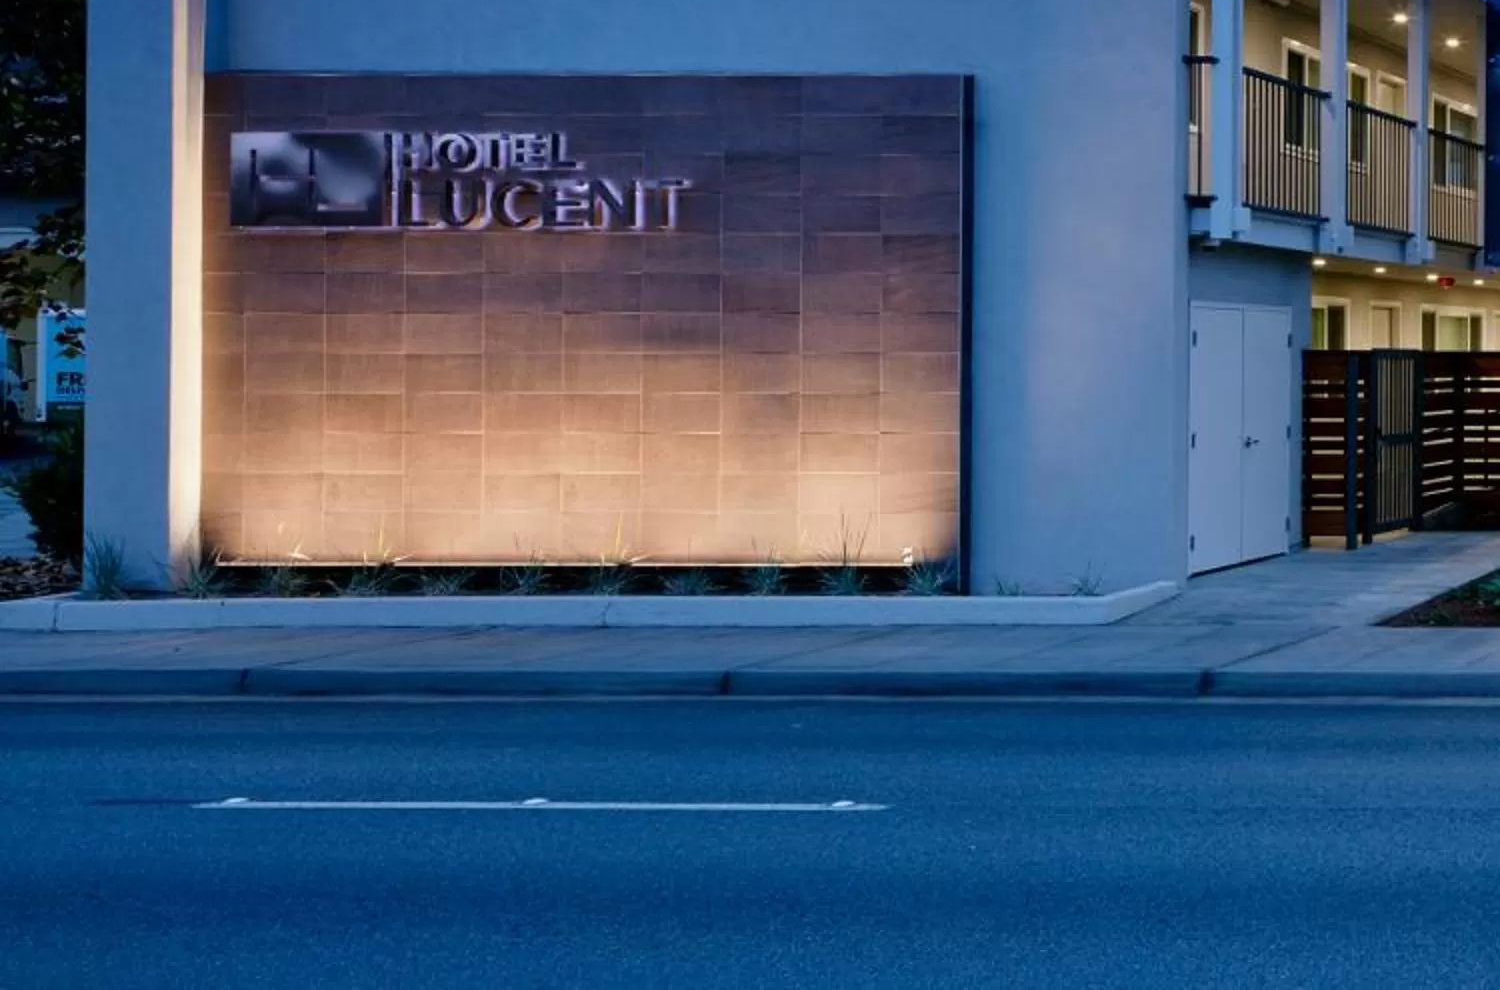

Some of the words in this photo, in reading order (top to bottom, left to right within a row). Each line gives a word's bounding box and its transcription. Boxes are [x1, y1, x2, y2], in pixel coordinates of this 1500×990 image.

[402, 131, 584, 172] HOTEL
[402, 177, 691, 230] LUCENT
[57, 371, 86, 386] FR
